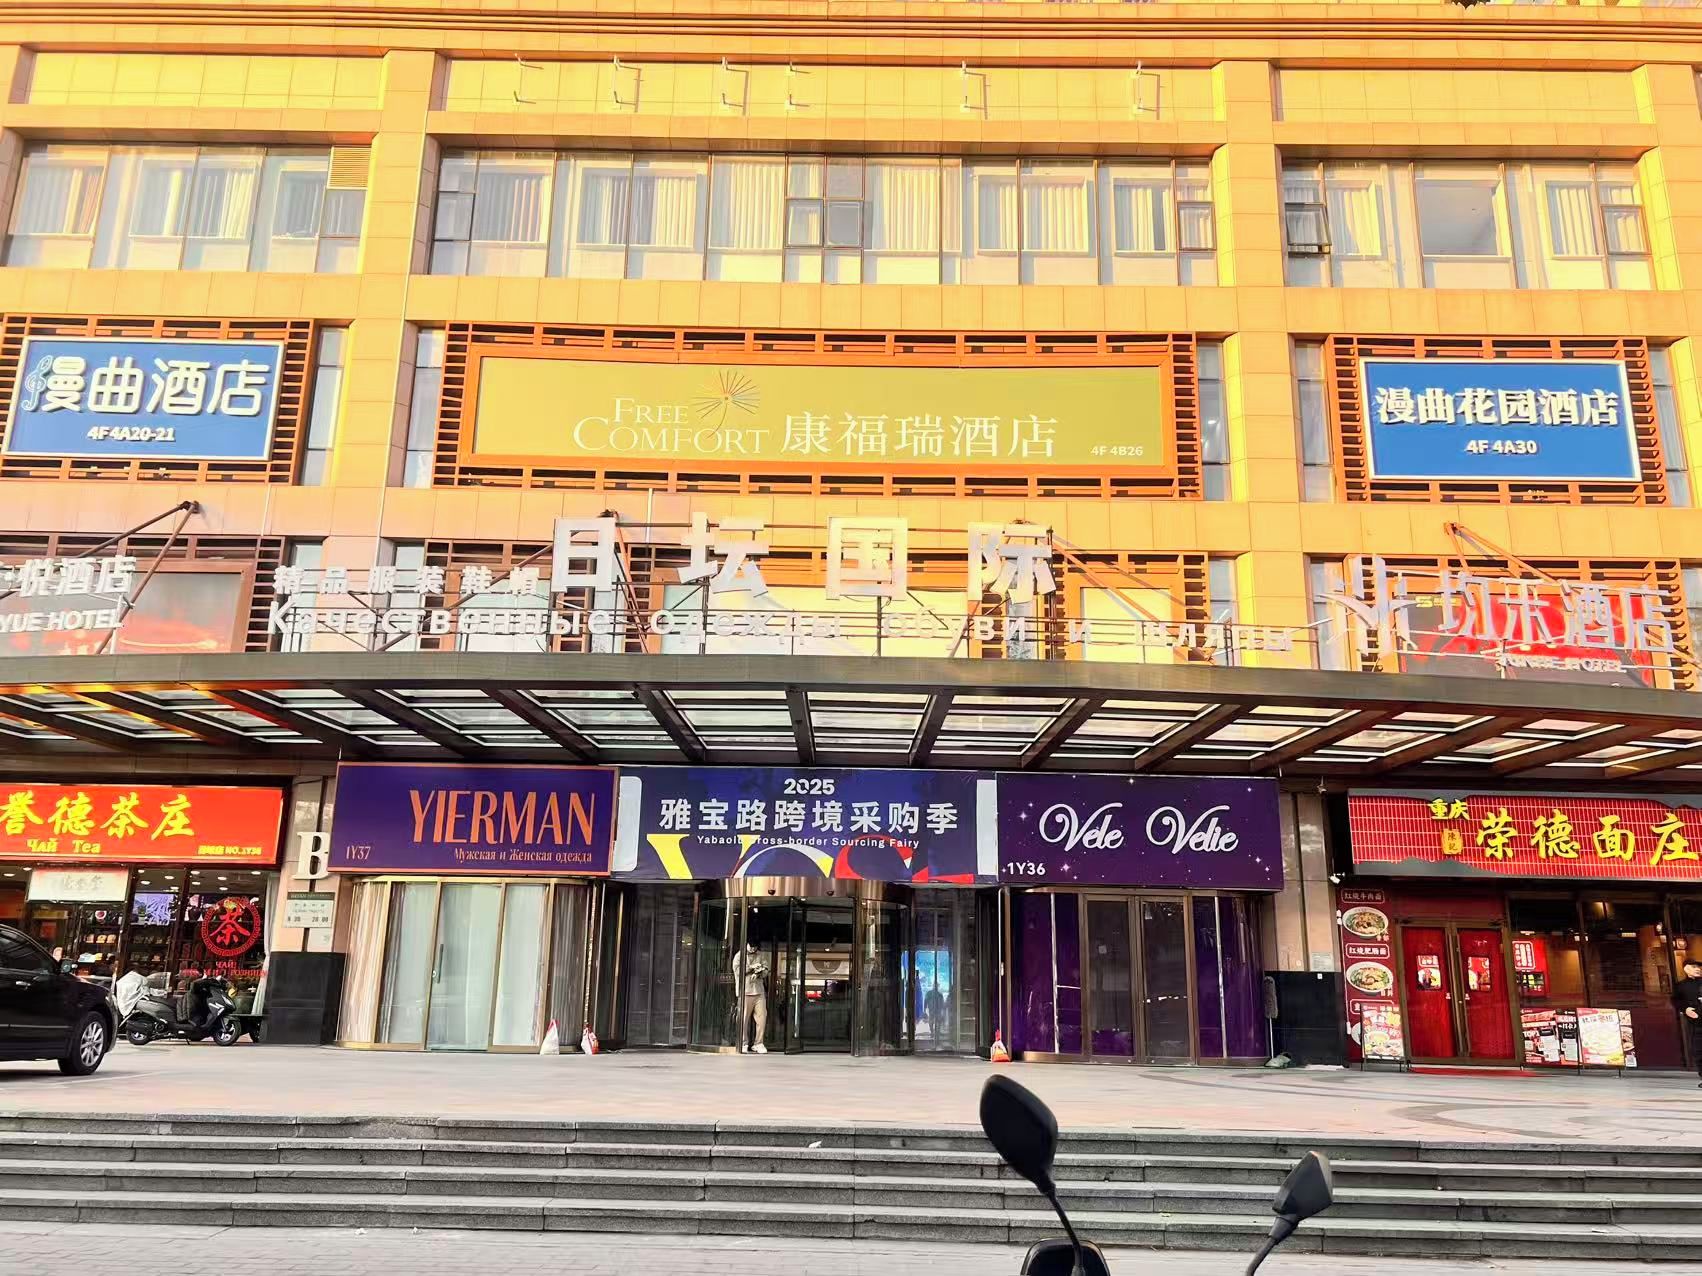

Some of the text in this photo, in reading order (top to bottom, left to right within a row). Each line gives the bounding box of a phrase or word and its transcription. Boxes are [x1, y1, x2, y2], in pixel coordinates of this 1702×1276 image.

[613, 397, 689, 424] FREE
[1375, 387, 1619, 425] 漫曲花园酒店
[573, 416, 769, 454] COMFORT
[780, 411, 1058, 457] 康福瑞酒店
[1090, 446, 1144, 456] 4F 4B26
[1466, 440, 1538, 455] 4F 4A30
[552, 511, 1057, 604] 日坛国际
[44, 607, 123, 631] HOTEL
[783, 778, 835, 795] 2025
[409, 789, 595, 845] YIERMAN
[659, 798, 958, 835] 雅宝路跨境采购季
[1428, 799, 1470, 820] 重庆
[72, 839, 101, 854] Tea
[832, 837, 885, 849] Sourcing
[1477, 808, 1701, 866] 荣德面庄
[292, 831, 331, 880] B
[509, 848, 551, 862] Женская
[555, 852, 592, 864] одежда
[1007, 862, 1046, 875] 1Y36
